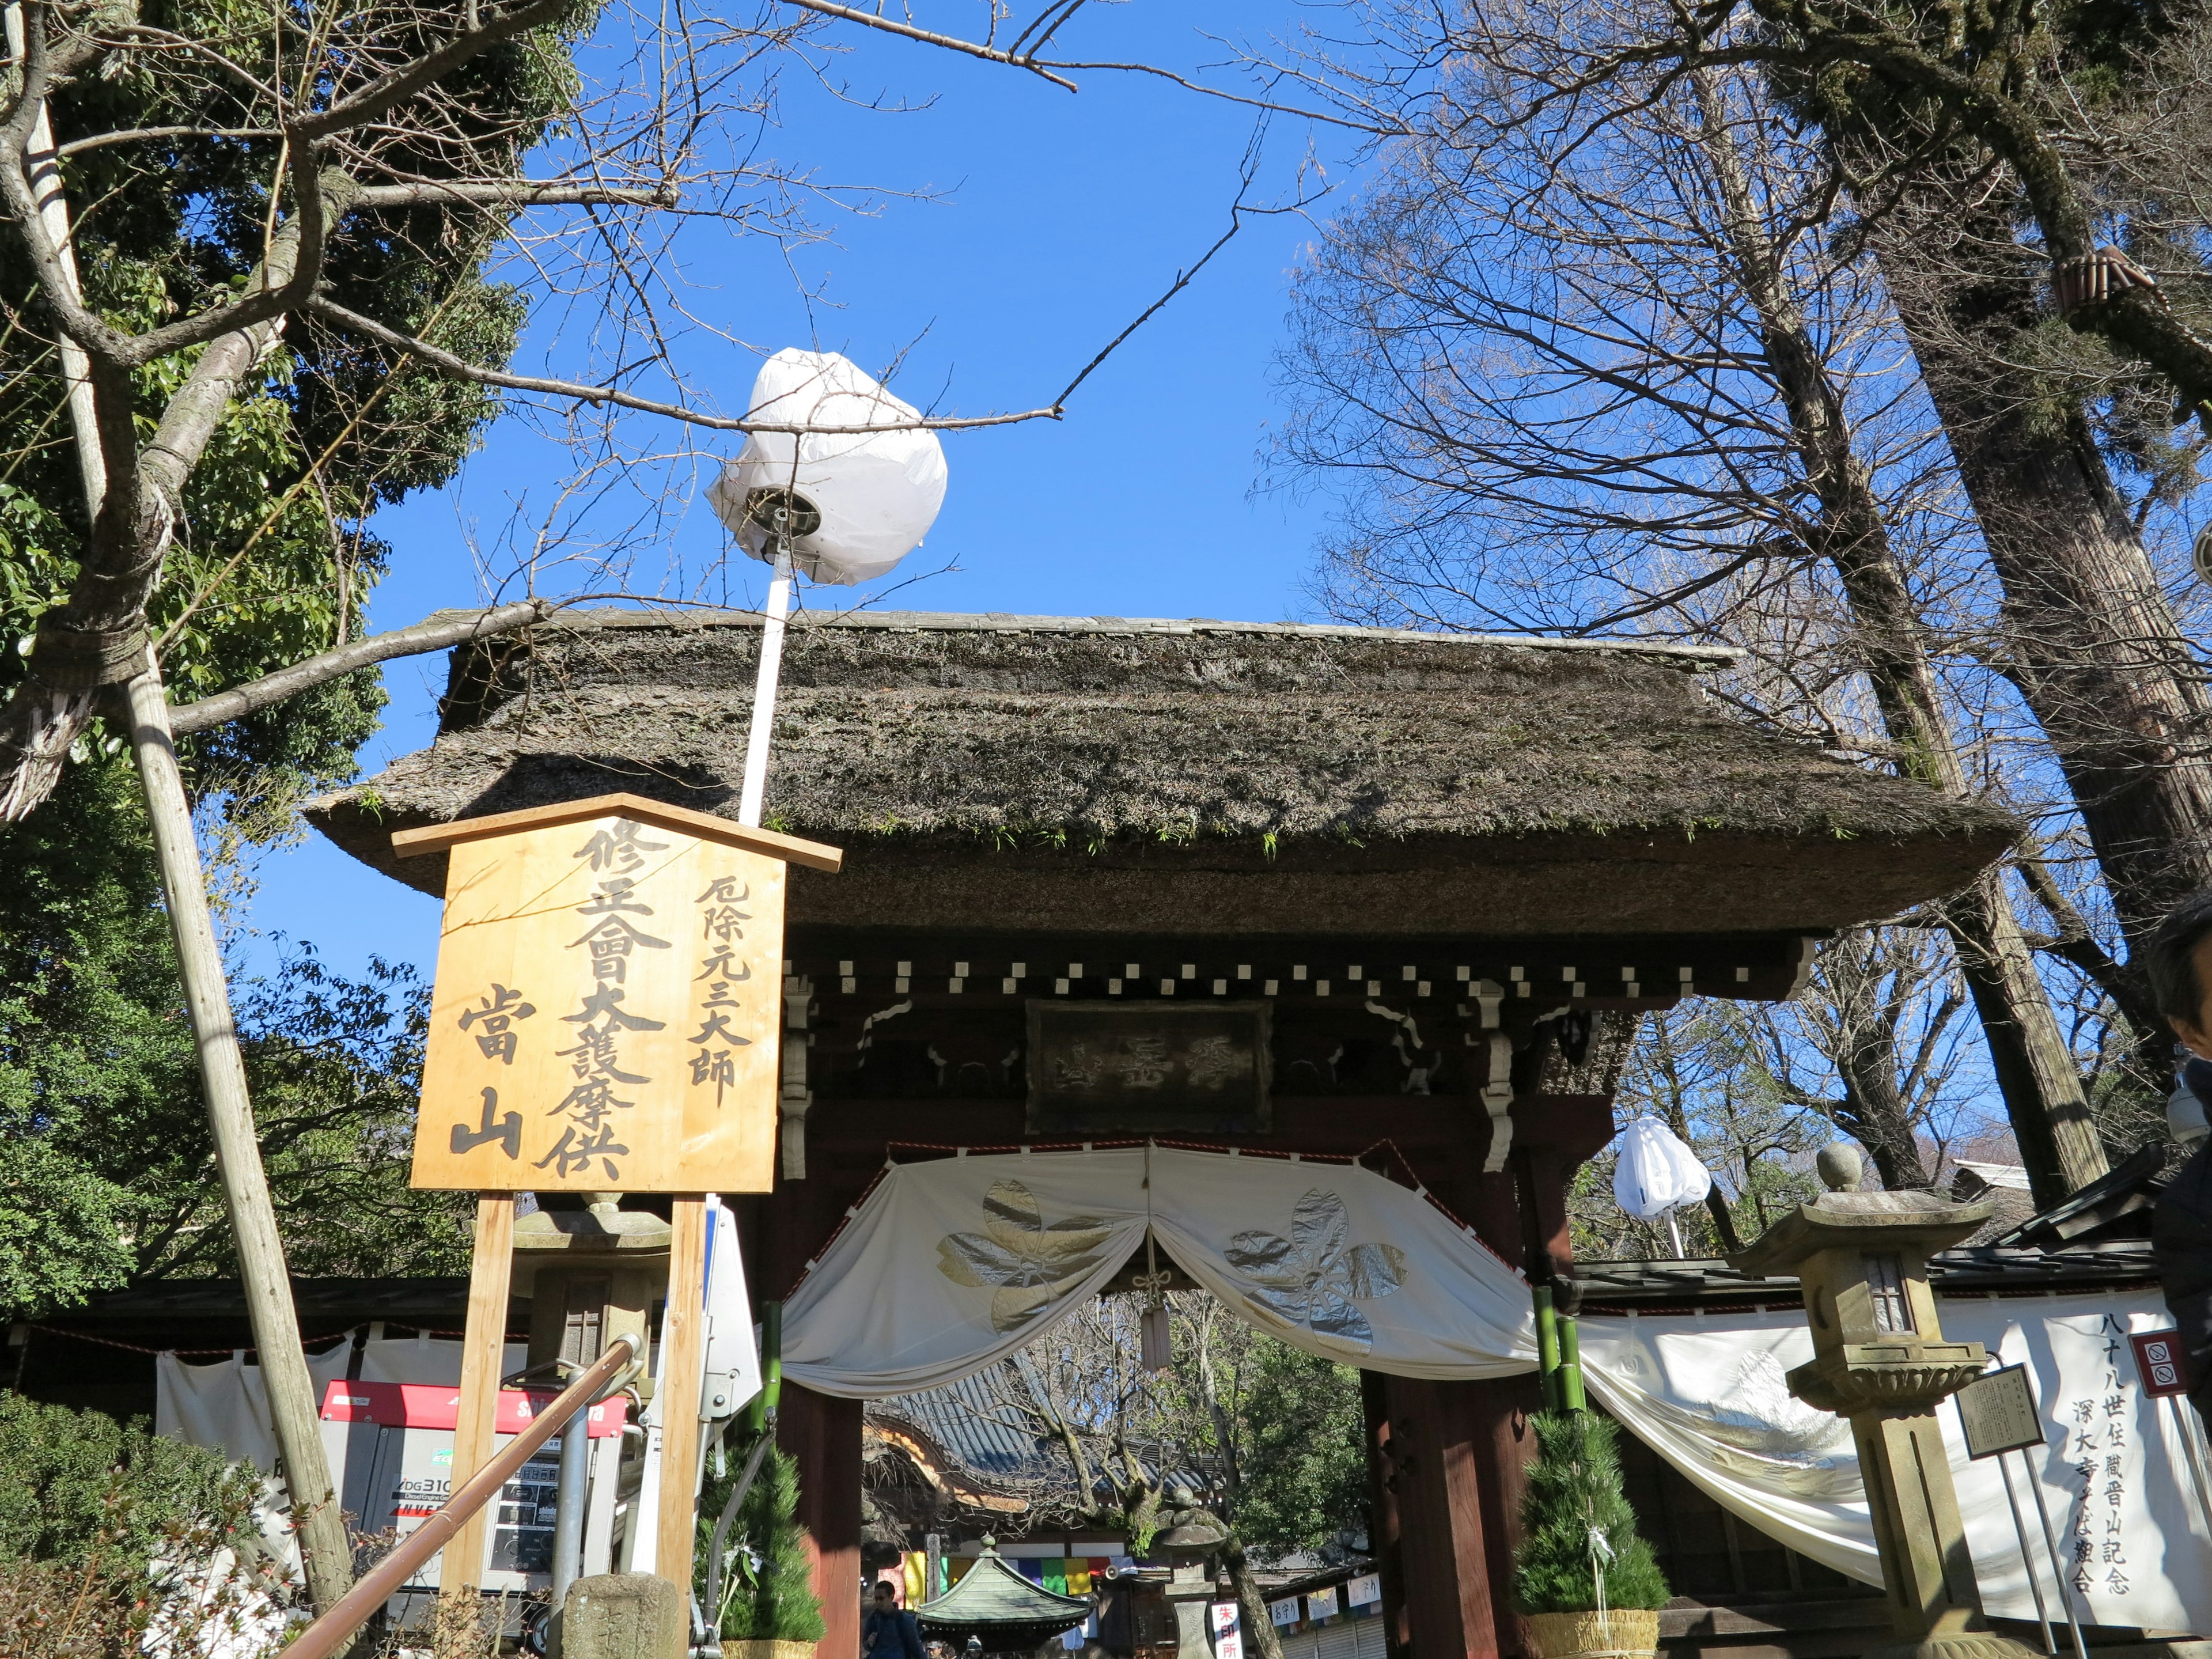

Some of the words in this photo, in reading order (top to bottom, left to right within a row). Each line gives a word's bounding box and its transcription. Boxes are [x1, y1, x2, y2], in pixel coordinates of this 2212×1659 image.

[450, 983, 537, 1160] 當山
[687, 875, 753, 1109] 厄除元三大師
[2071, 1399, 2100, 1594] 深大寺そば組合
[2100, 1313, 2130, 1595] 八十八世住職晋山記念
[1219, 1606, 1236, 1658] 朱印所
[1275, 1601, 1295, 1621] お守り
[1353, 1579, 1376, 1600] お守り
